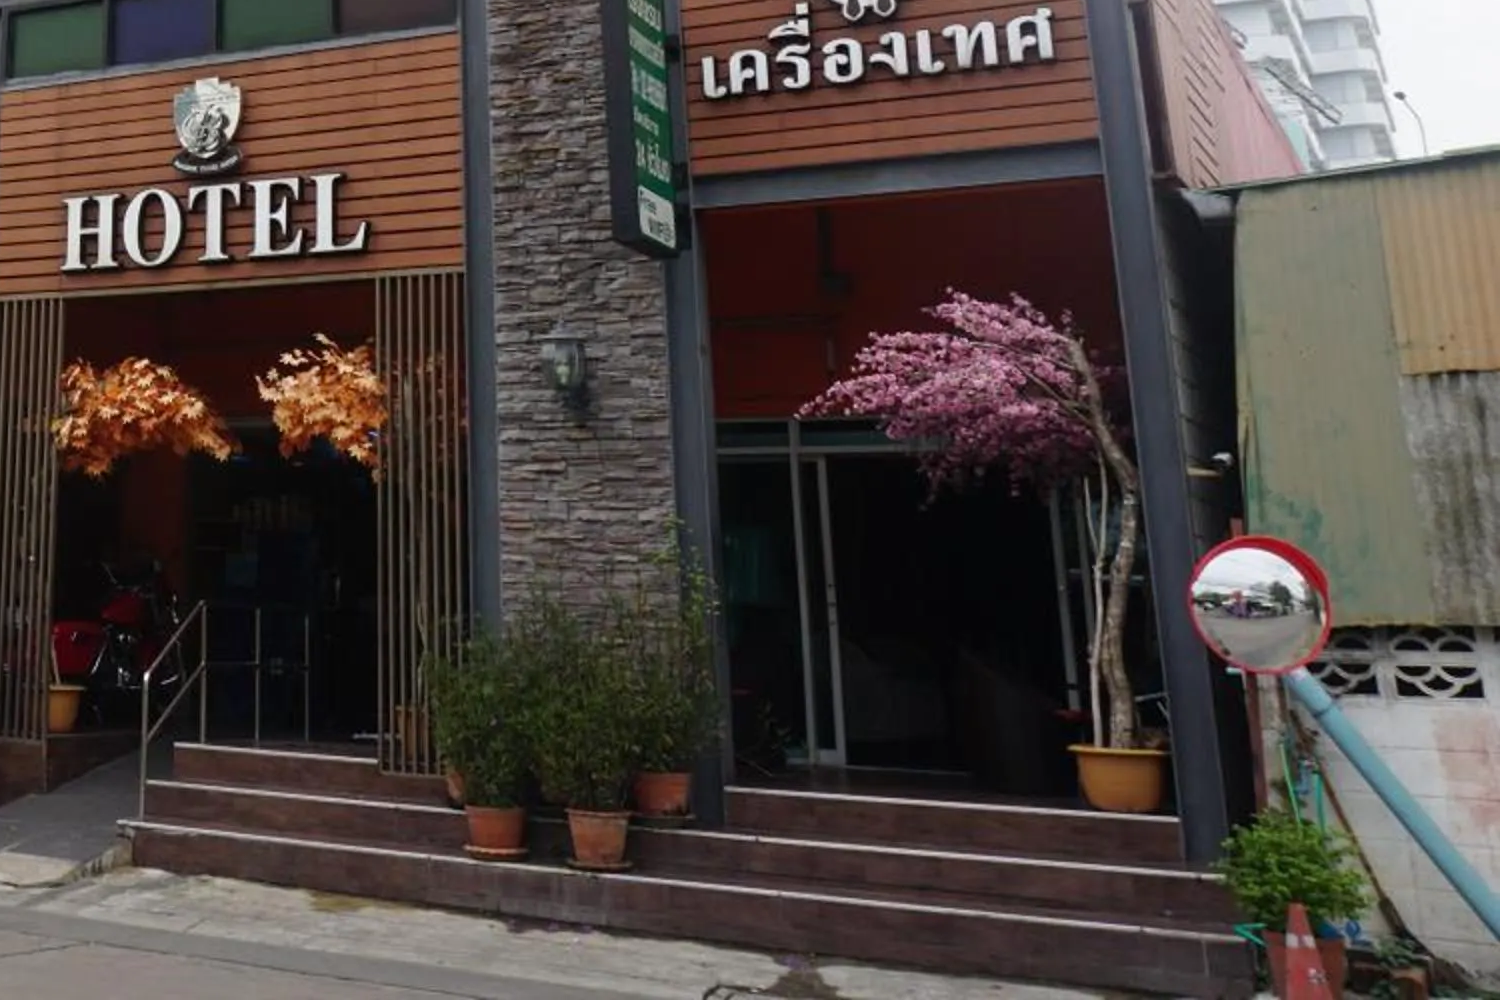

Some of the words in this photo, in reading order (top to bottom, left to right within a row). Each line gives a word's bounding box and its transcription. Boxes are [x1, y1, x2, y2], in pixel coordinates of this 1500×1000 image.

[700, 3, 1056, 100] เครื่องเทศ
[60, 172, 370, 273] HOTEL
